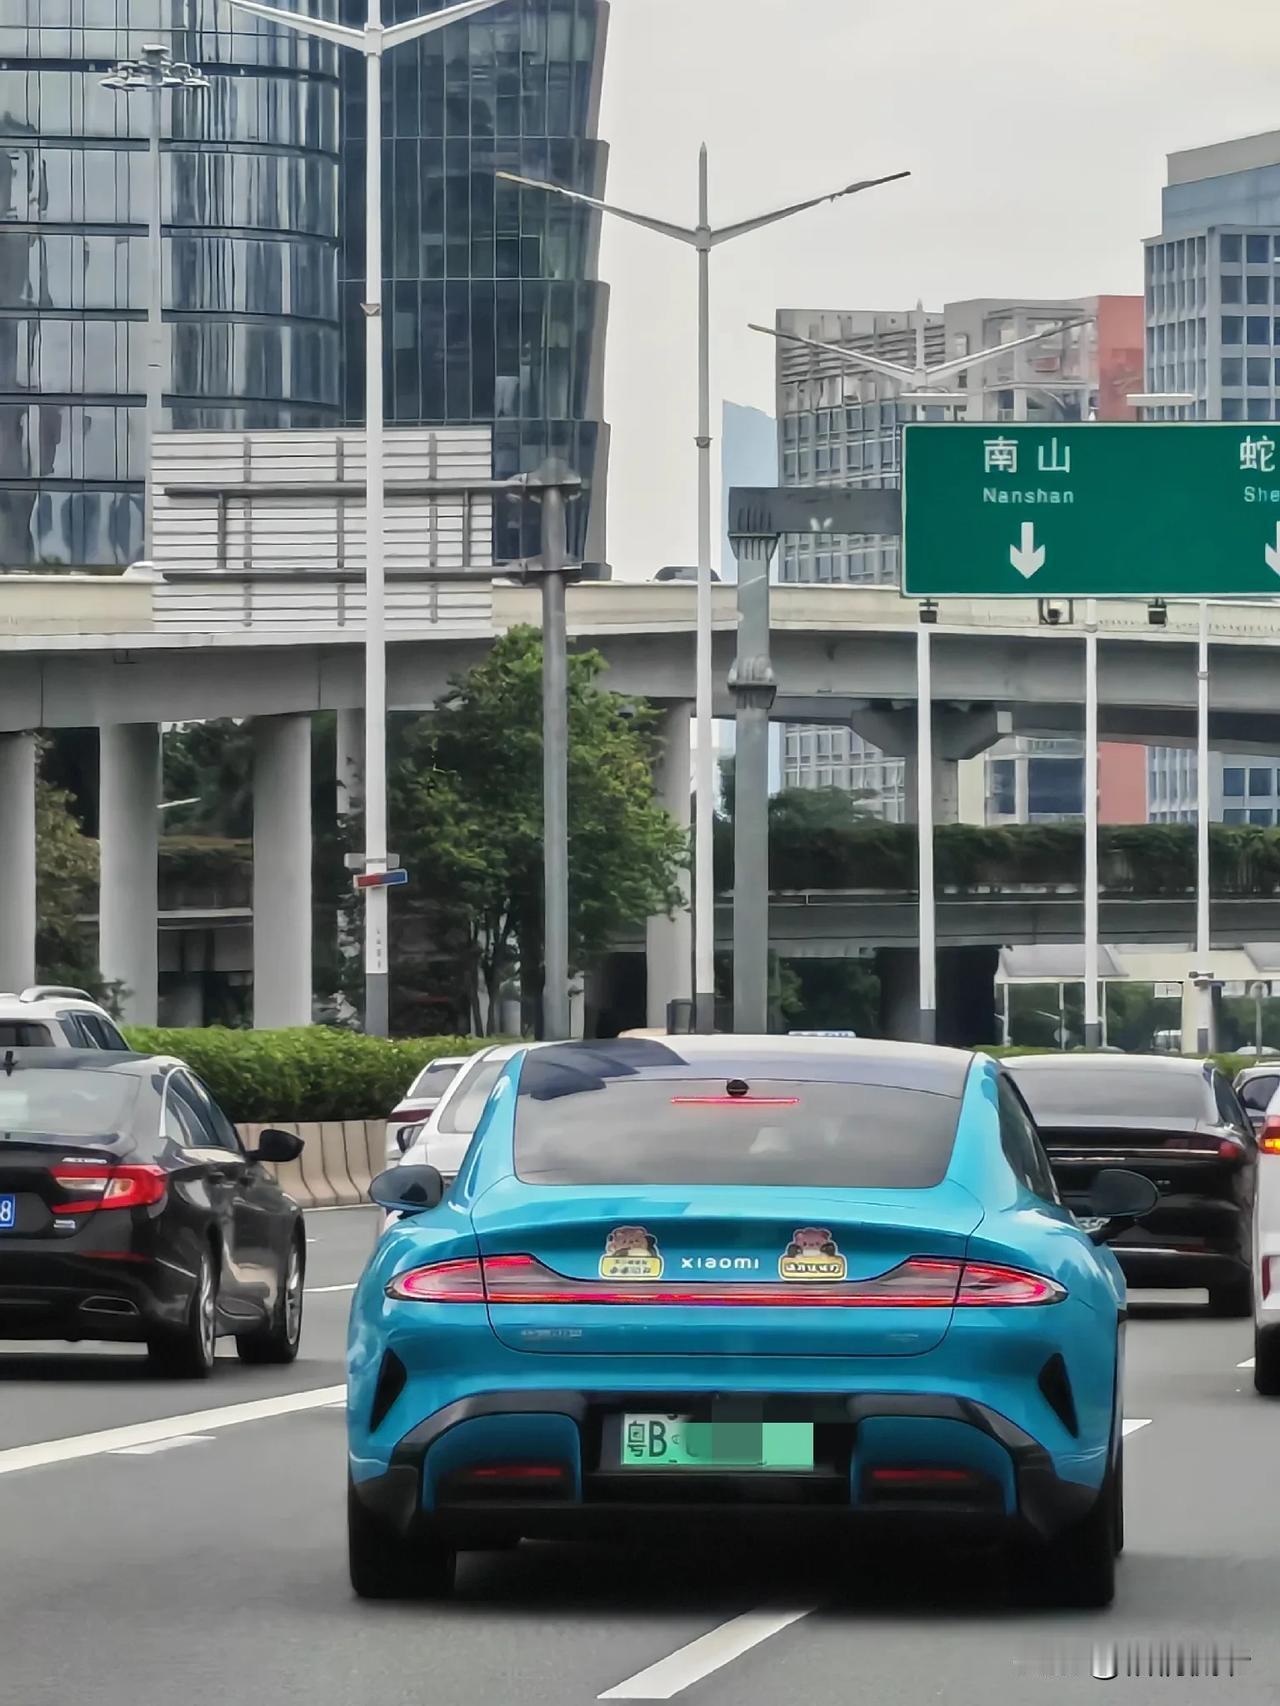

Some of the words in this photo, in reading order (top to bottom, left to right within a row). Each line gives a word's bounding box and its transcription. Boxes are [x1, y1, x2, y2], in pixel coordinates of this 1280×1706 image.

[983, 435, 1070, 473] 南山
[1240, 435, 1276, 472] 蛇
[983, 487, 1074, 504] Nanshan
[681, 1257, 760, 1270] xiaomi
